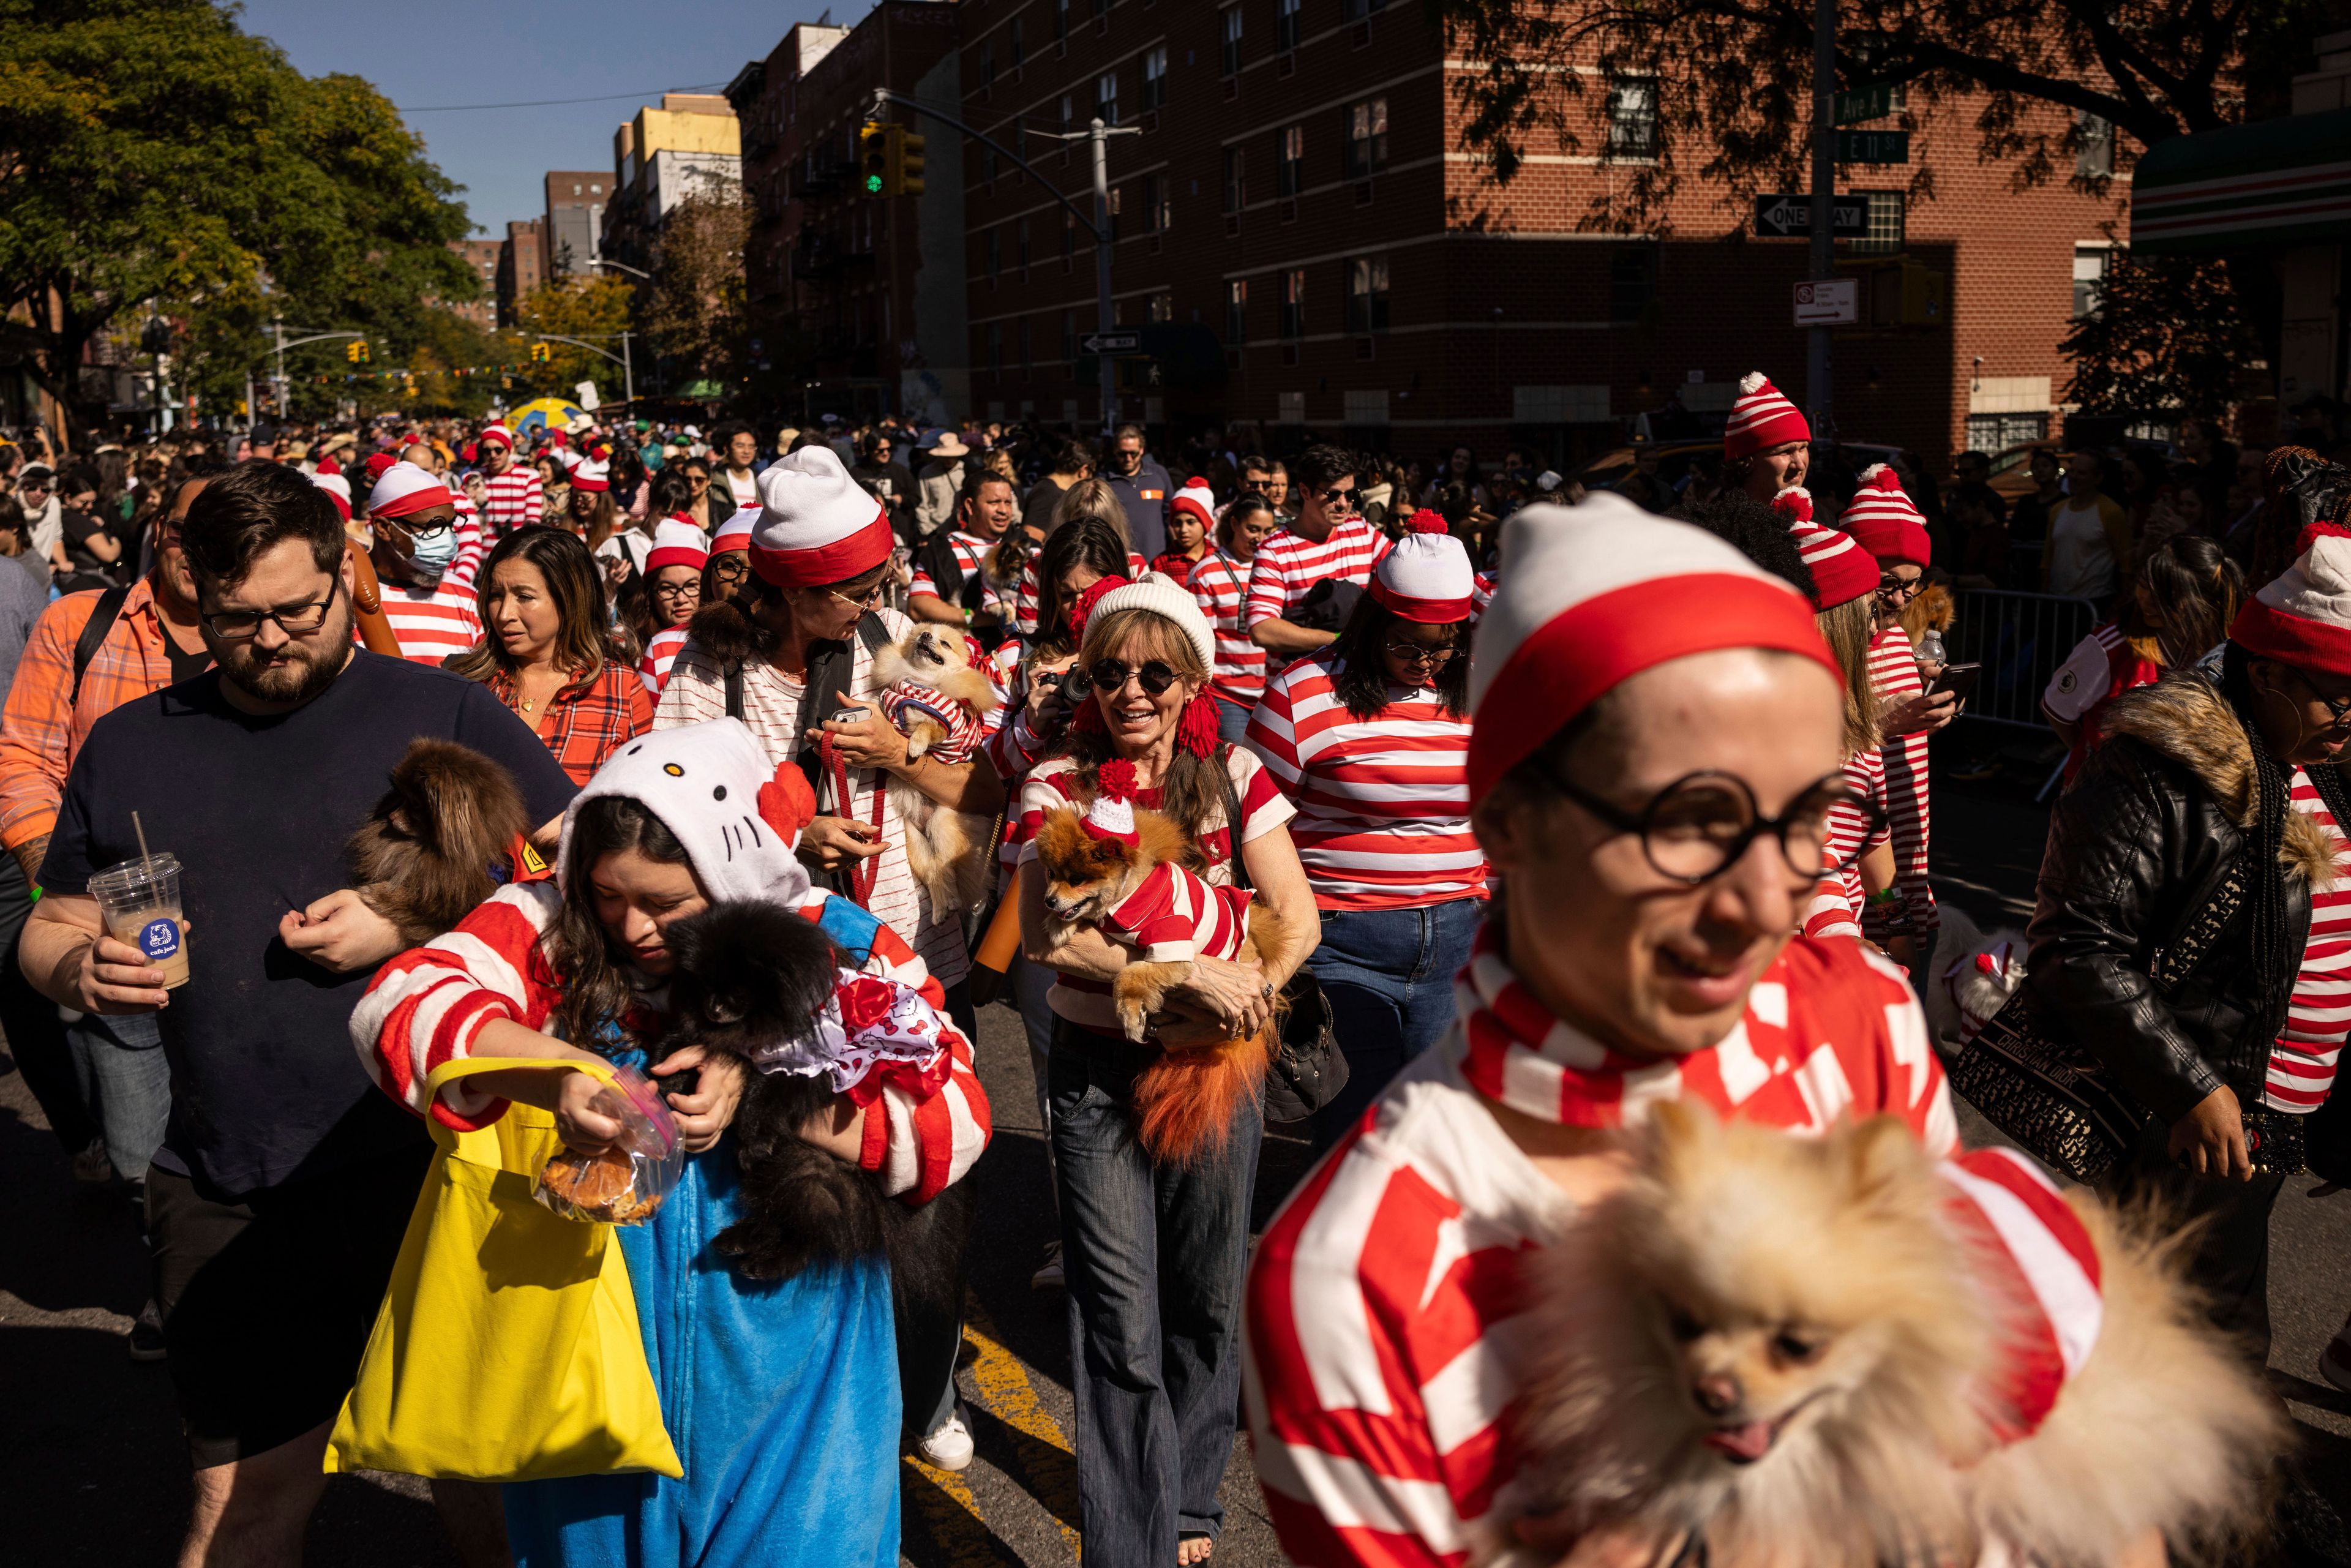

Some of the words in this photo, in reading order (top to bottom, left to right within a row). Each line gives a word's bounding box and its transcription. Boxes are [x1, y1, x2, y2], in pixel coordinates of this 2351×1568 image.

[1843, 96, 1865, 120] Ave
[1869, 89, 1880, 115] A
[1850, 135, 1859, 159] E
[1867, 135, 1878, 159] 11
[1884, 135, 1896, 151] St
[1774, 208, 1805, 225] ONE
[1832, 208, 1854, 225] AY
[163, 944, 176, 954] joah
[1997, 1033, 2052, 1071] CHRISTIAN
[2049, 1064, 2079, 1089] DIOR
